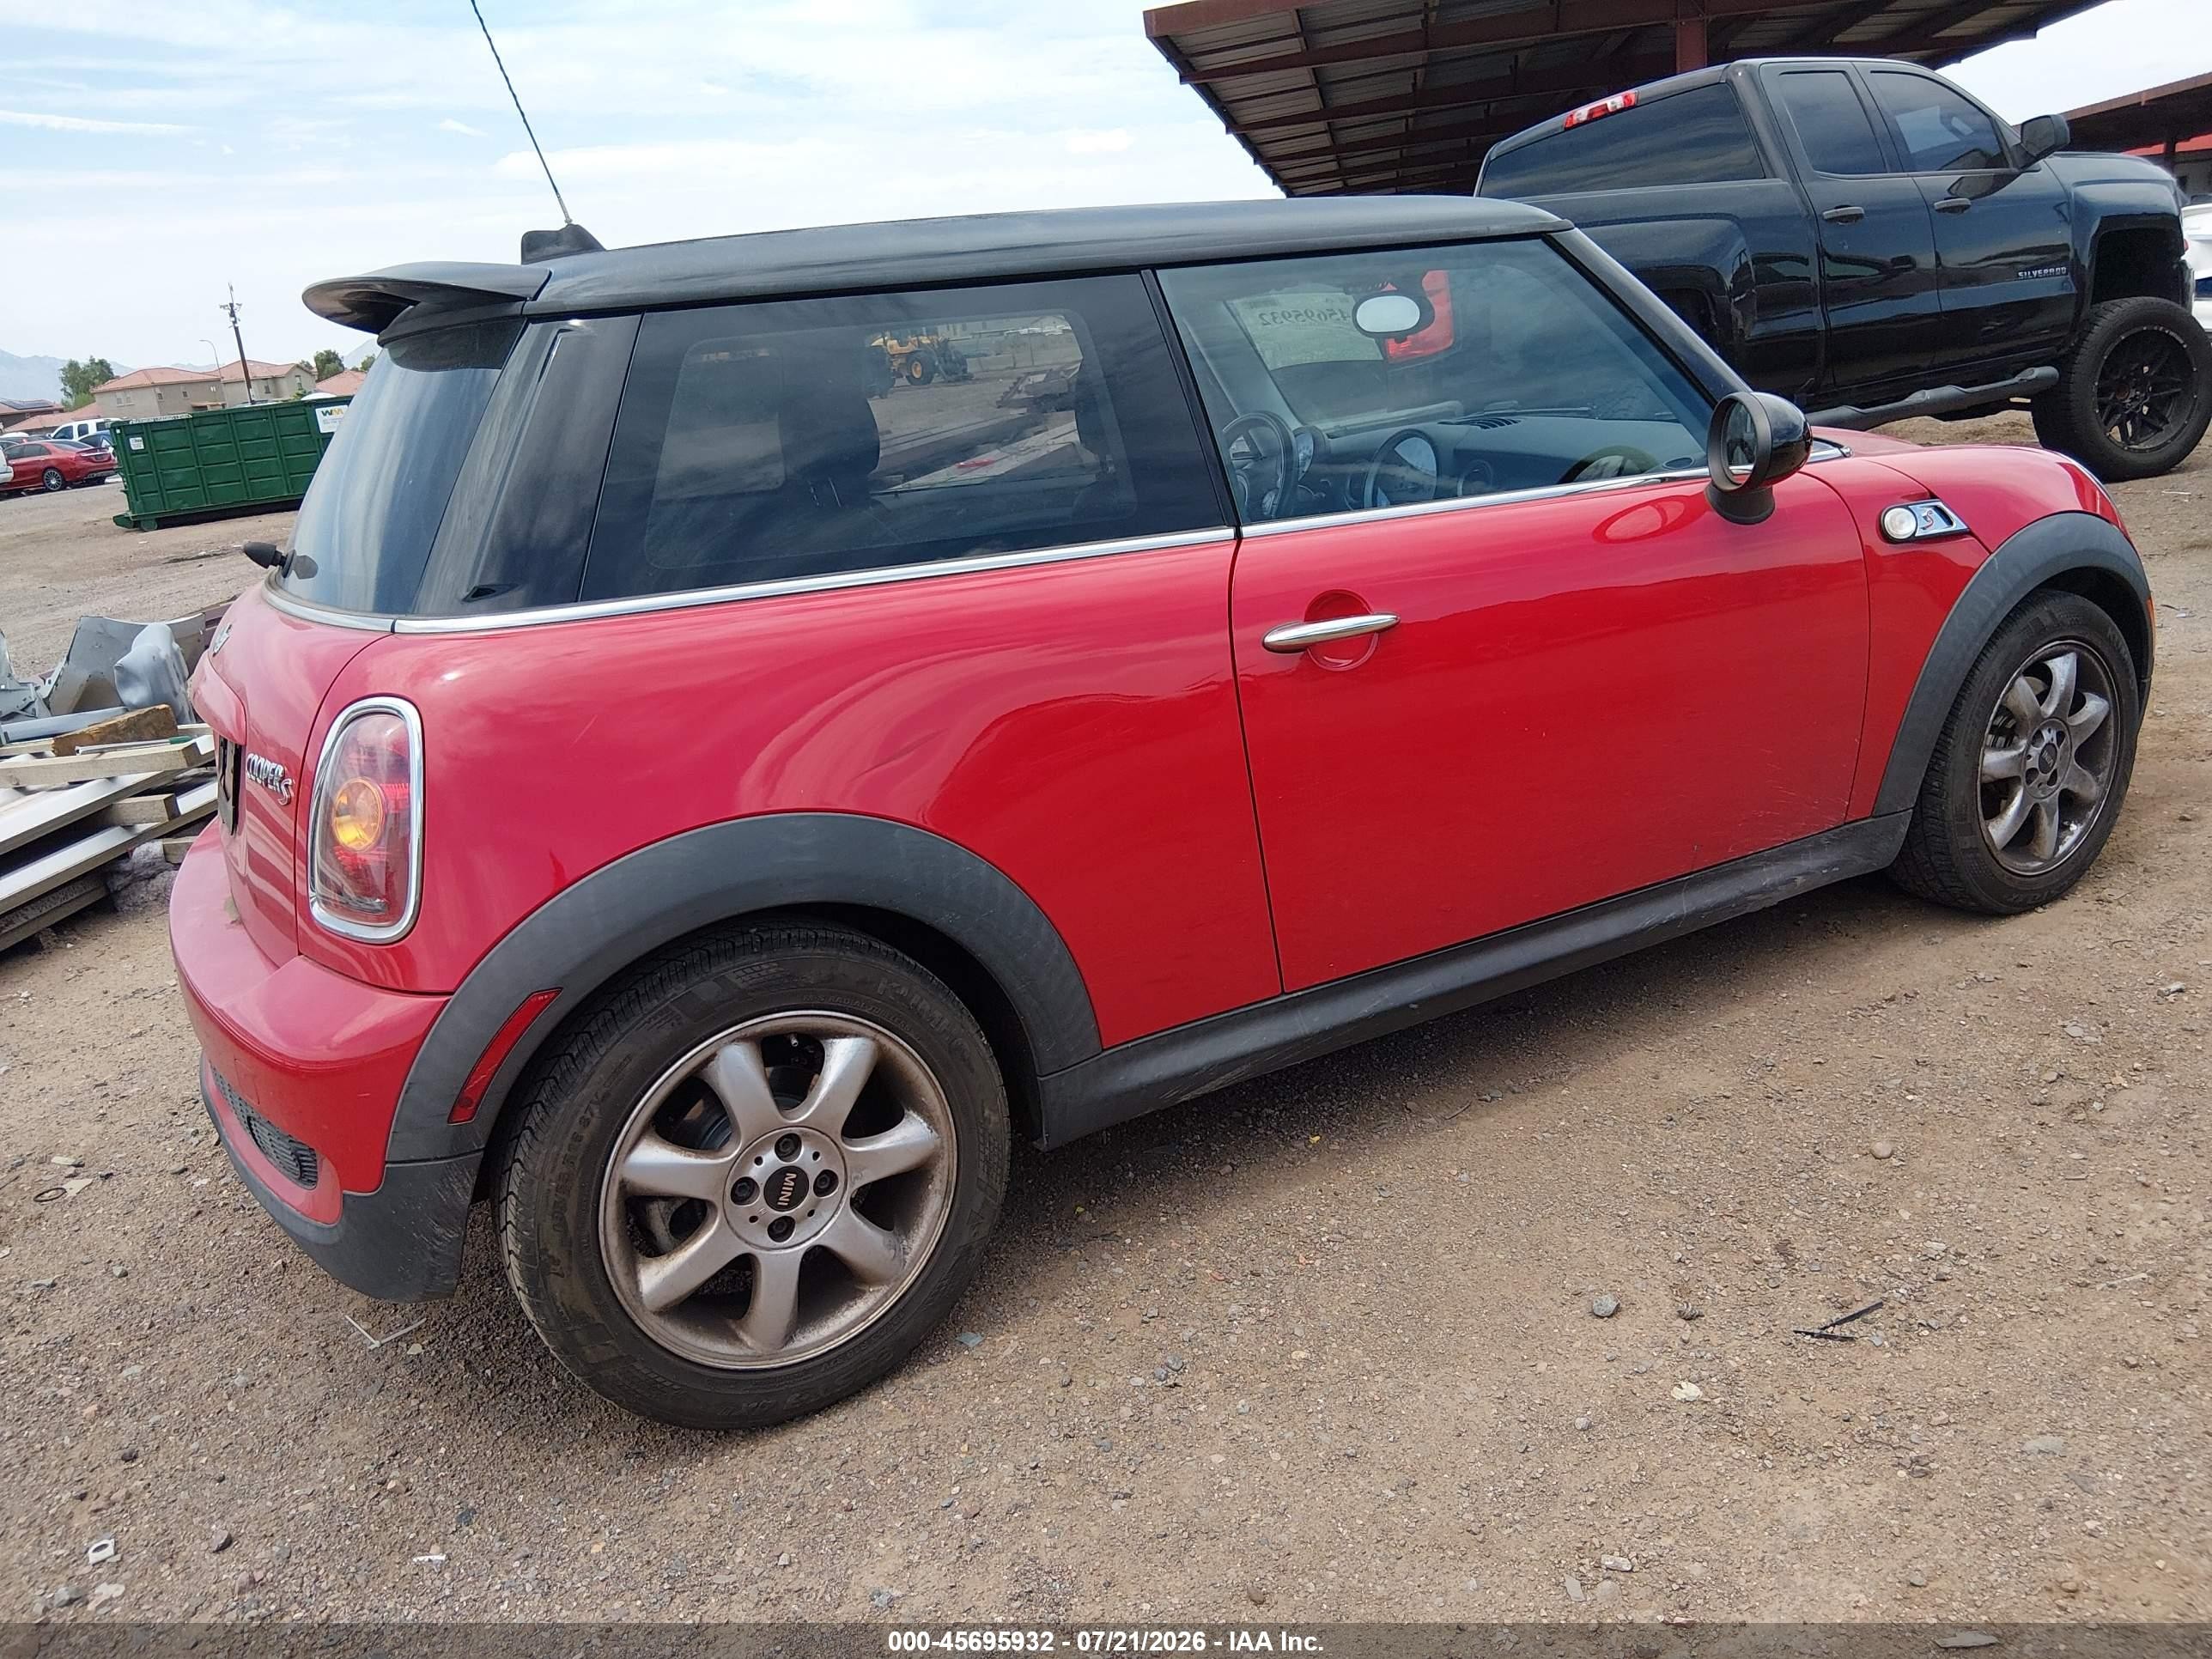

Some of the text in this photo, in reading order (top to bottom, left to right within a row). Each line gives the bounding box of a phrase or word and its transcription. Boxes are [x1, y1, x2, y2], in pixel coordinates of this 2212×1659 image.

[2017, 266, 2067, 280] SILVERADO
[246, 752, 295, 805] COOPER S
[776, 1172, 798, 1206] MINI
